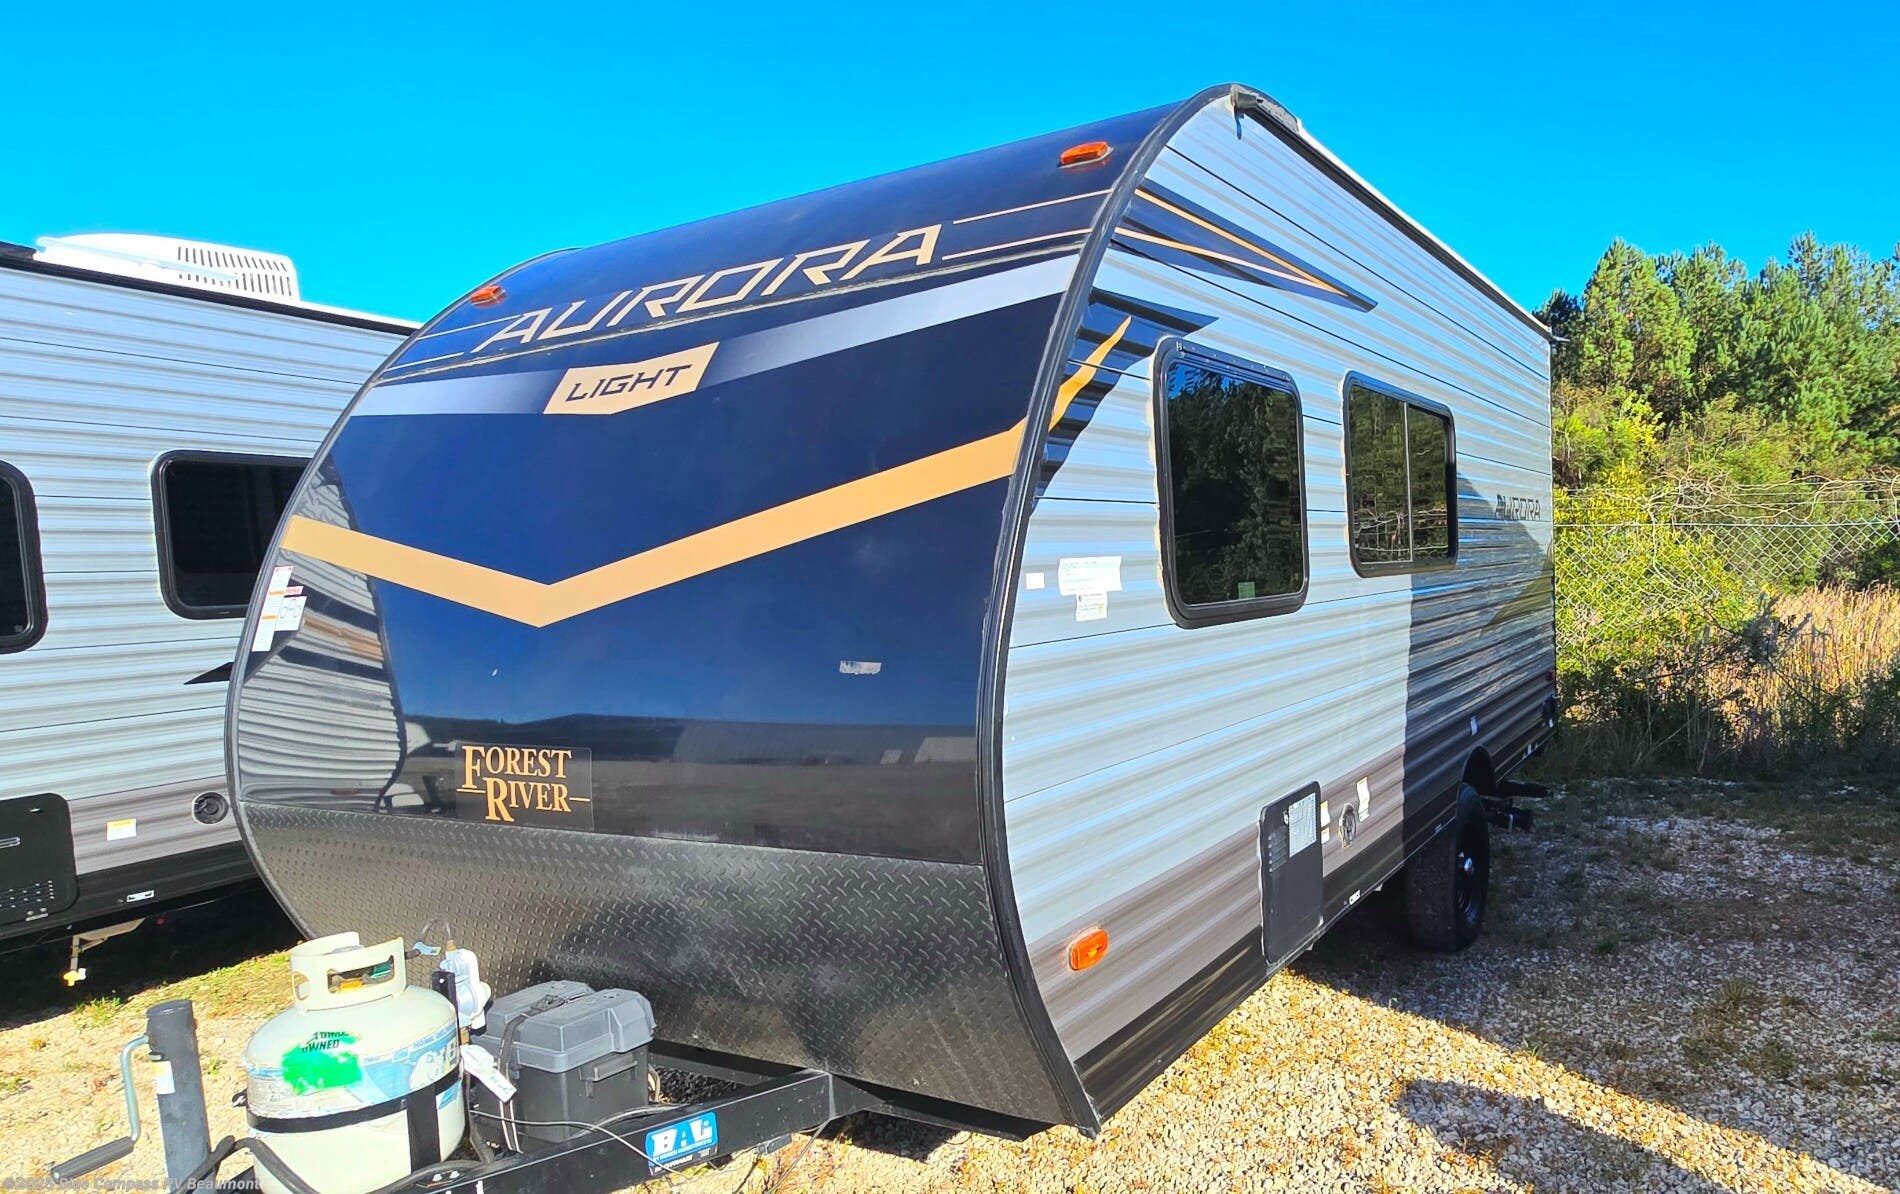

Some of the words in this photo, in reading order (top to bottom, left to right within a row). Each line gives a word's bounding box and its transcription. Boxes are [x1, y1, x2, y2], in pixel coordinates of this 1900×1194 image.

[470, 223, 942, 354] AURORA
[565, 364, 693, 402] LIGHT
[1494, 493, 1541, 521] AURORA
[461, 745, 573, 789] FOREST
[482, 776, 572, 822] RIVER
[650, 1118, 714, 1158] BAL
